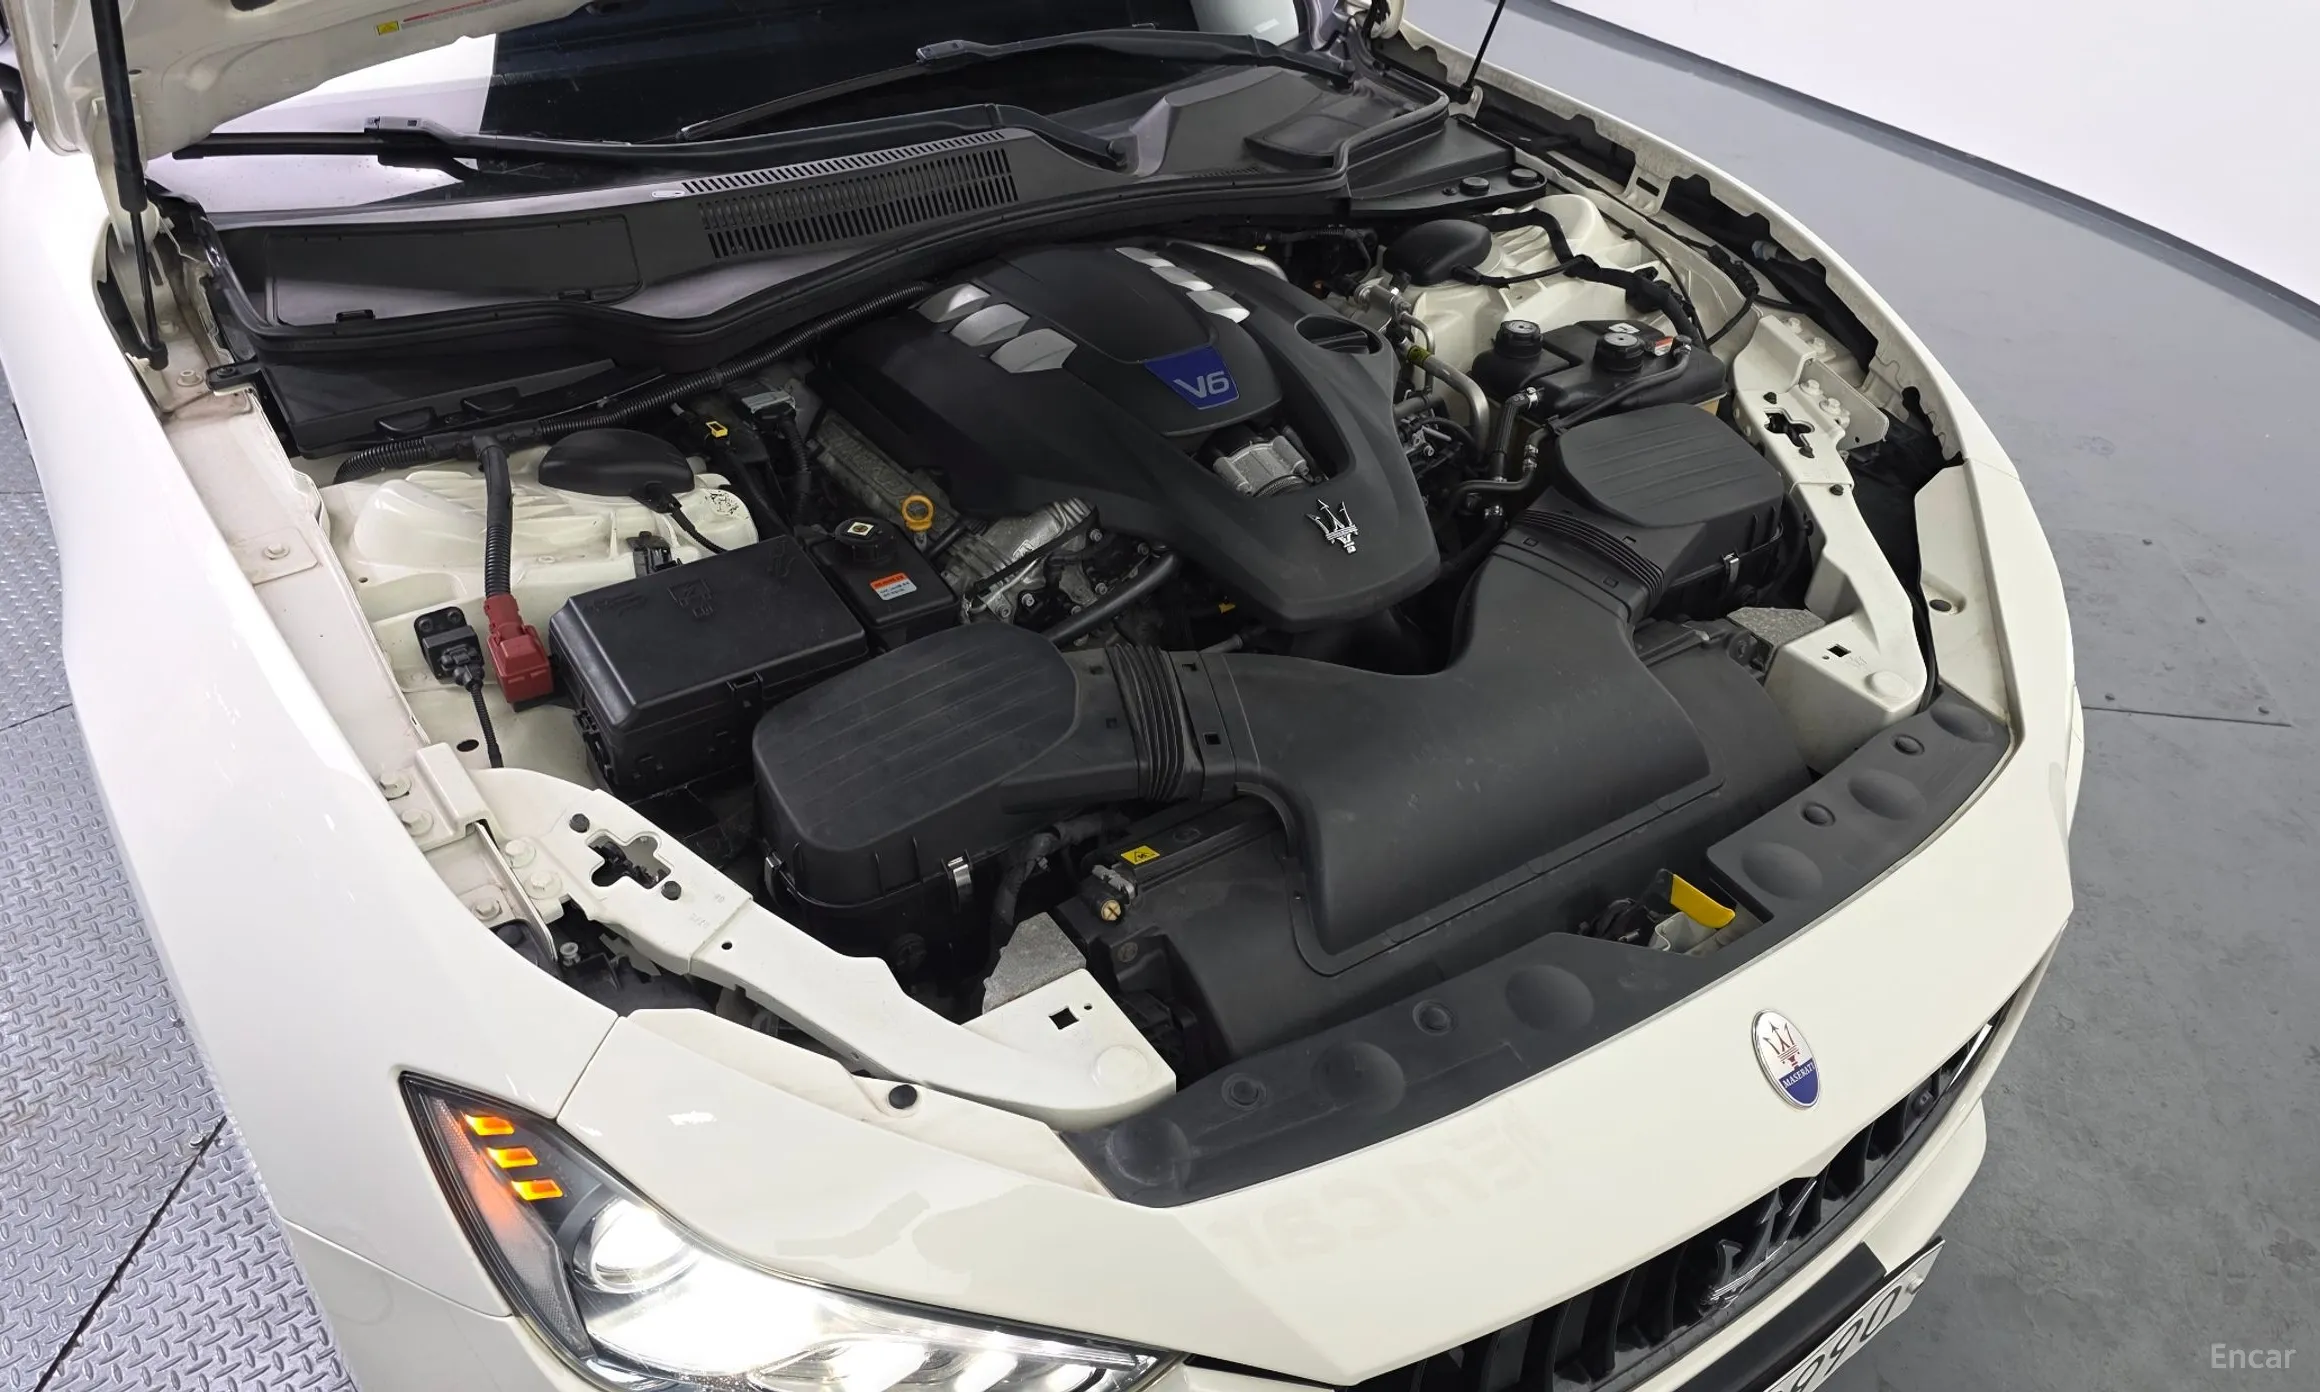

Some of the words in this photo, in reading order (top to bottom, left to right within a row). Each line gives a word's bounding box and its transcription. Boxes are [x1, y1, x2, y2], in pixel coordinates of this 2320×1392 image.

[1173, 370, 1230, 398] V6
[1782, 1062, 1816, 1089] MASERATI
[1777, 1285, 1903, 1392] 990
